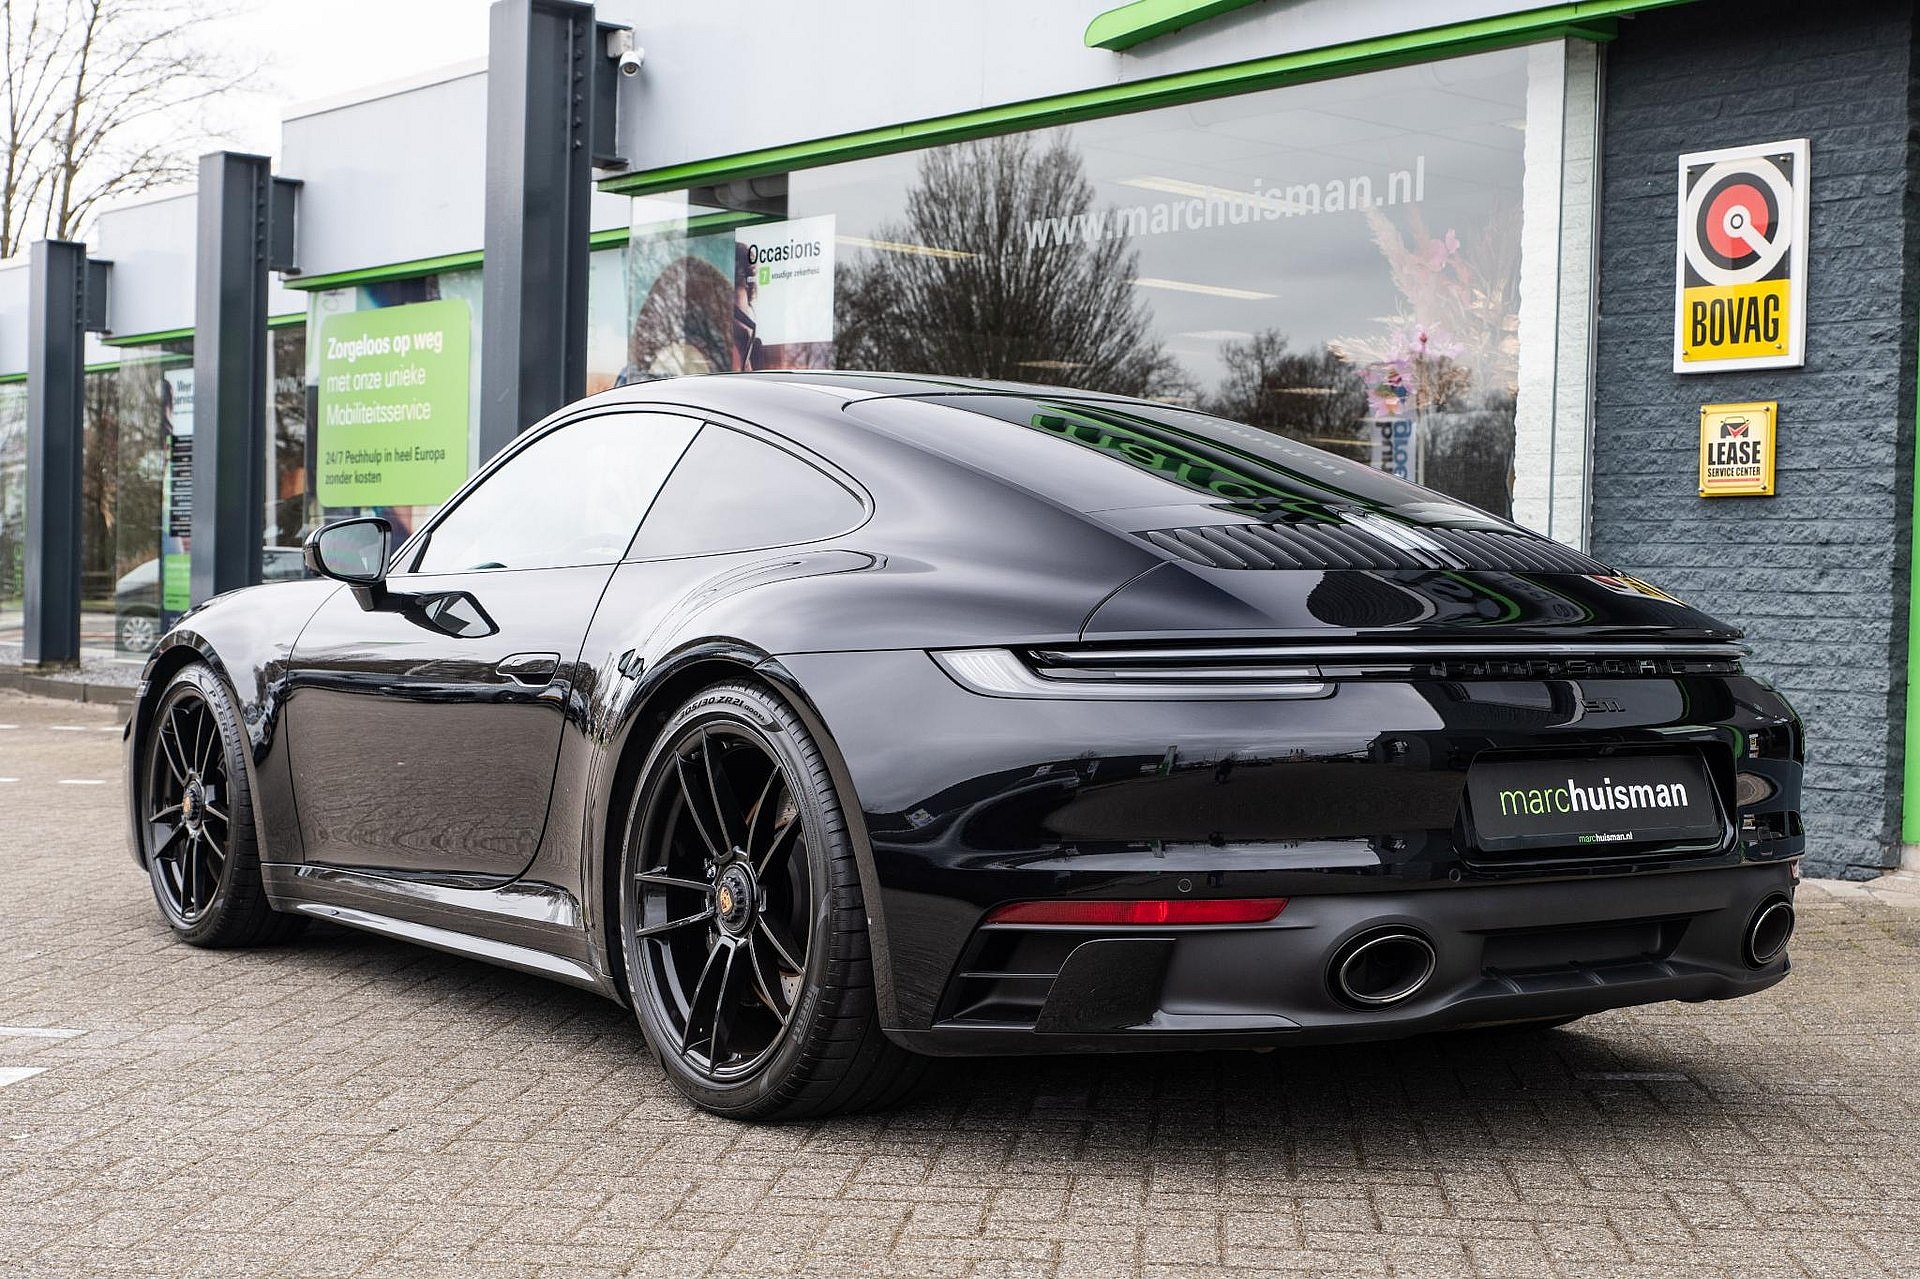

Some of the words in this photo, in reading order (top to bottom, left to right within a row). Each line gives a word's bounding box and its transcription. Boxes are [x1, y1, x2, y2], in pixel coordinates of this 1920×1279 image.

[1024, 156, 1425, 248] www.marchuisman.nl
[749, 239, 821, 264] Occasions
[1692, 294, 1780, 347] BOVAG
[327, 333, 390, 363] Zorgeloos
[393, 334, 411, 357] op
[414, 331, 443, 354] weg
[327, 373, 350, 393] met
[353, 371, 382, 391] onze
[385, 363, 426, 388] unieke
[326, 398, 431, 426] Mobiliteitsservice
[325, 450, 344, 465] 24/7
[345, 448, 382, 465] Pechhulp
[384, 448, 393, 462] in
[394, 447, 412, 462] heel
[415, 446, 445, 463] Europa
[1708, 441, 1761, 465] LEASE
[325, 472, 353, 485] zonder
[355, 470, 382, 484] kosten
[1707, 467, 1734, 478] SERVICE
[1736, 466, 1761, 477] CENTER
[1580, 697, 1626, 713] 911
[1499, 777, 1689, 816] marchuisman
[1578, 831, 1633, 843] marchuisman.nl
